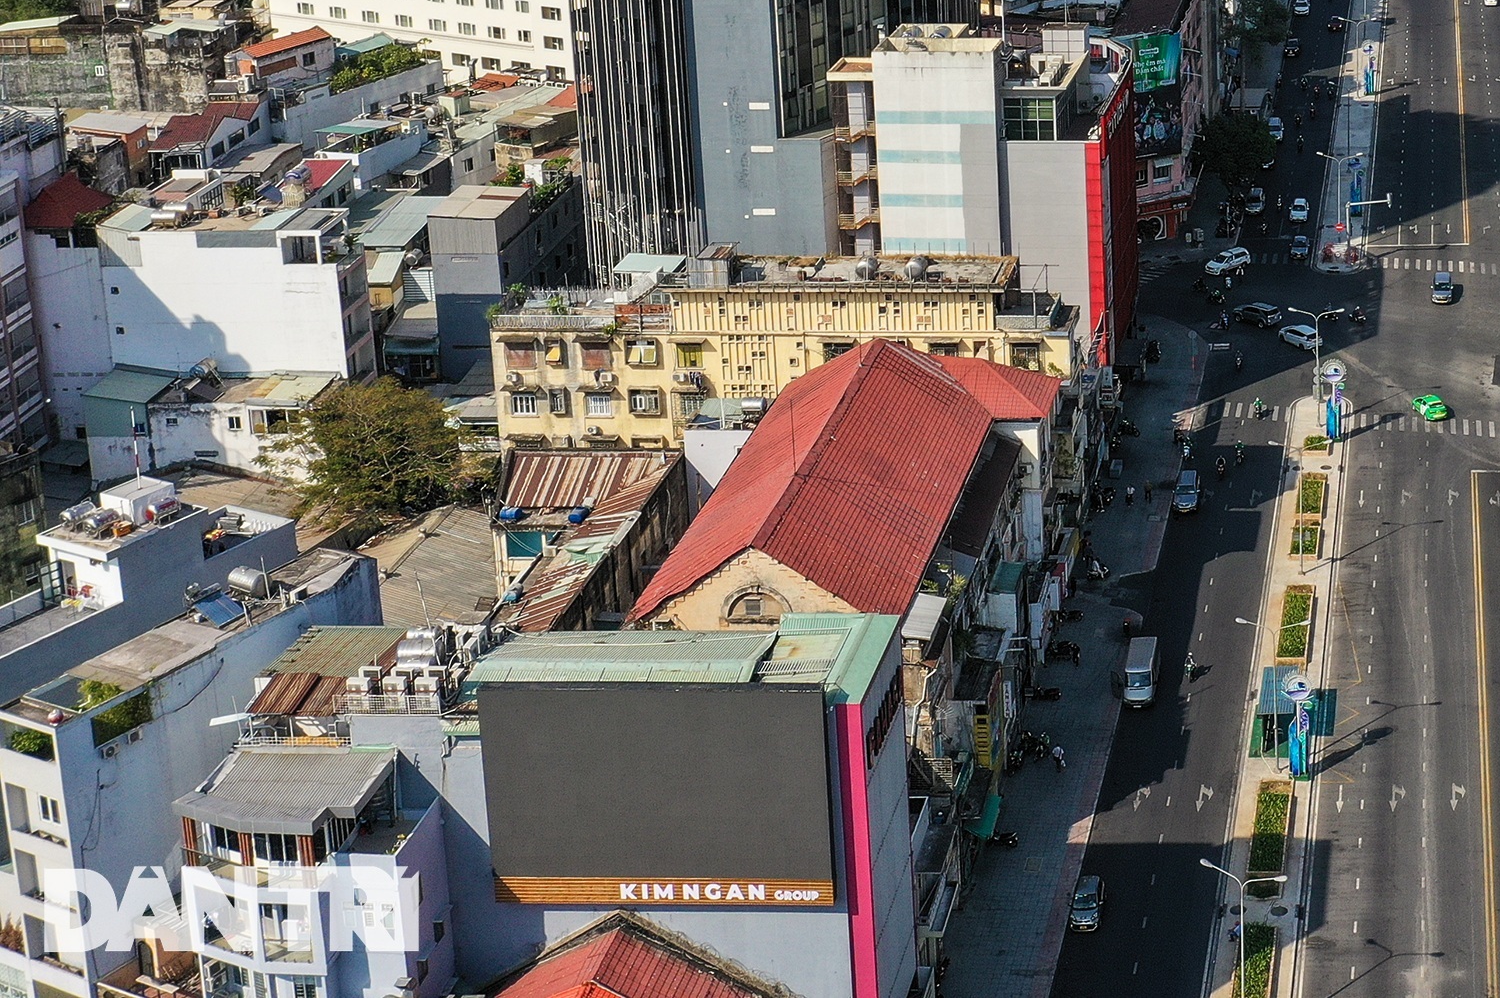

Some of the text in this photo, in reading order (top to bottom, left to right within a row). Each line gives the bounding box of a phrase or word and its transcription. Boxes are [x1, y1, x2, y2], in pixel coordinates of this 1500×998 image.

[619, 883, 820, 901] KIM NGAN GROUP
